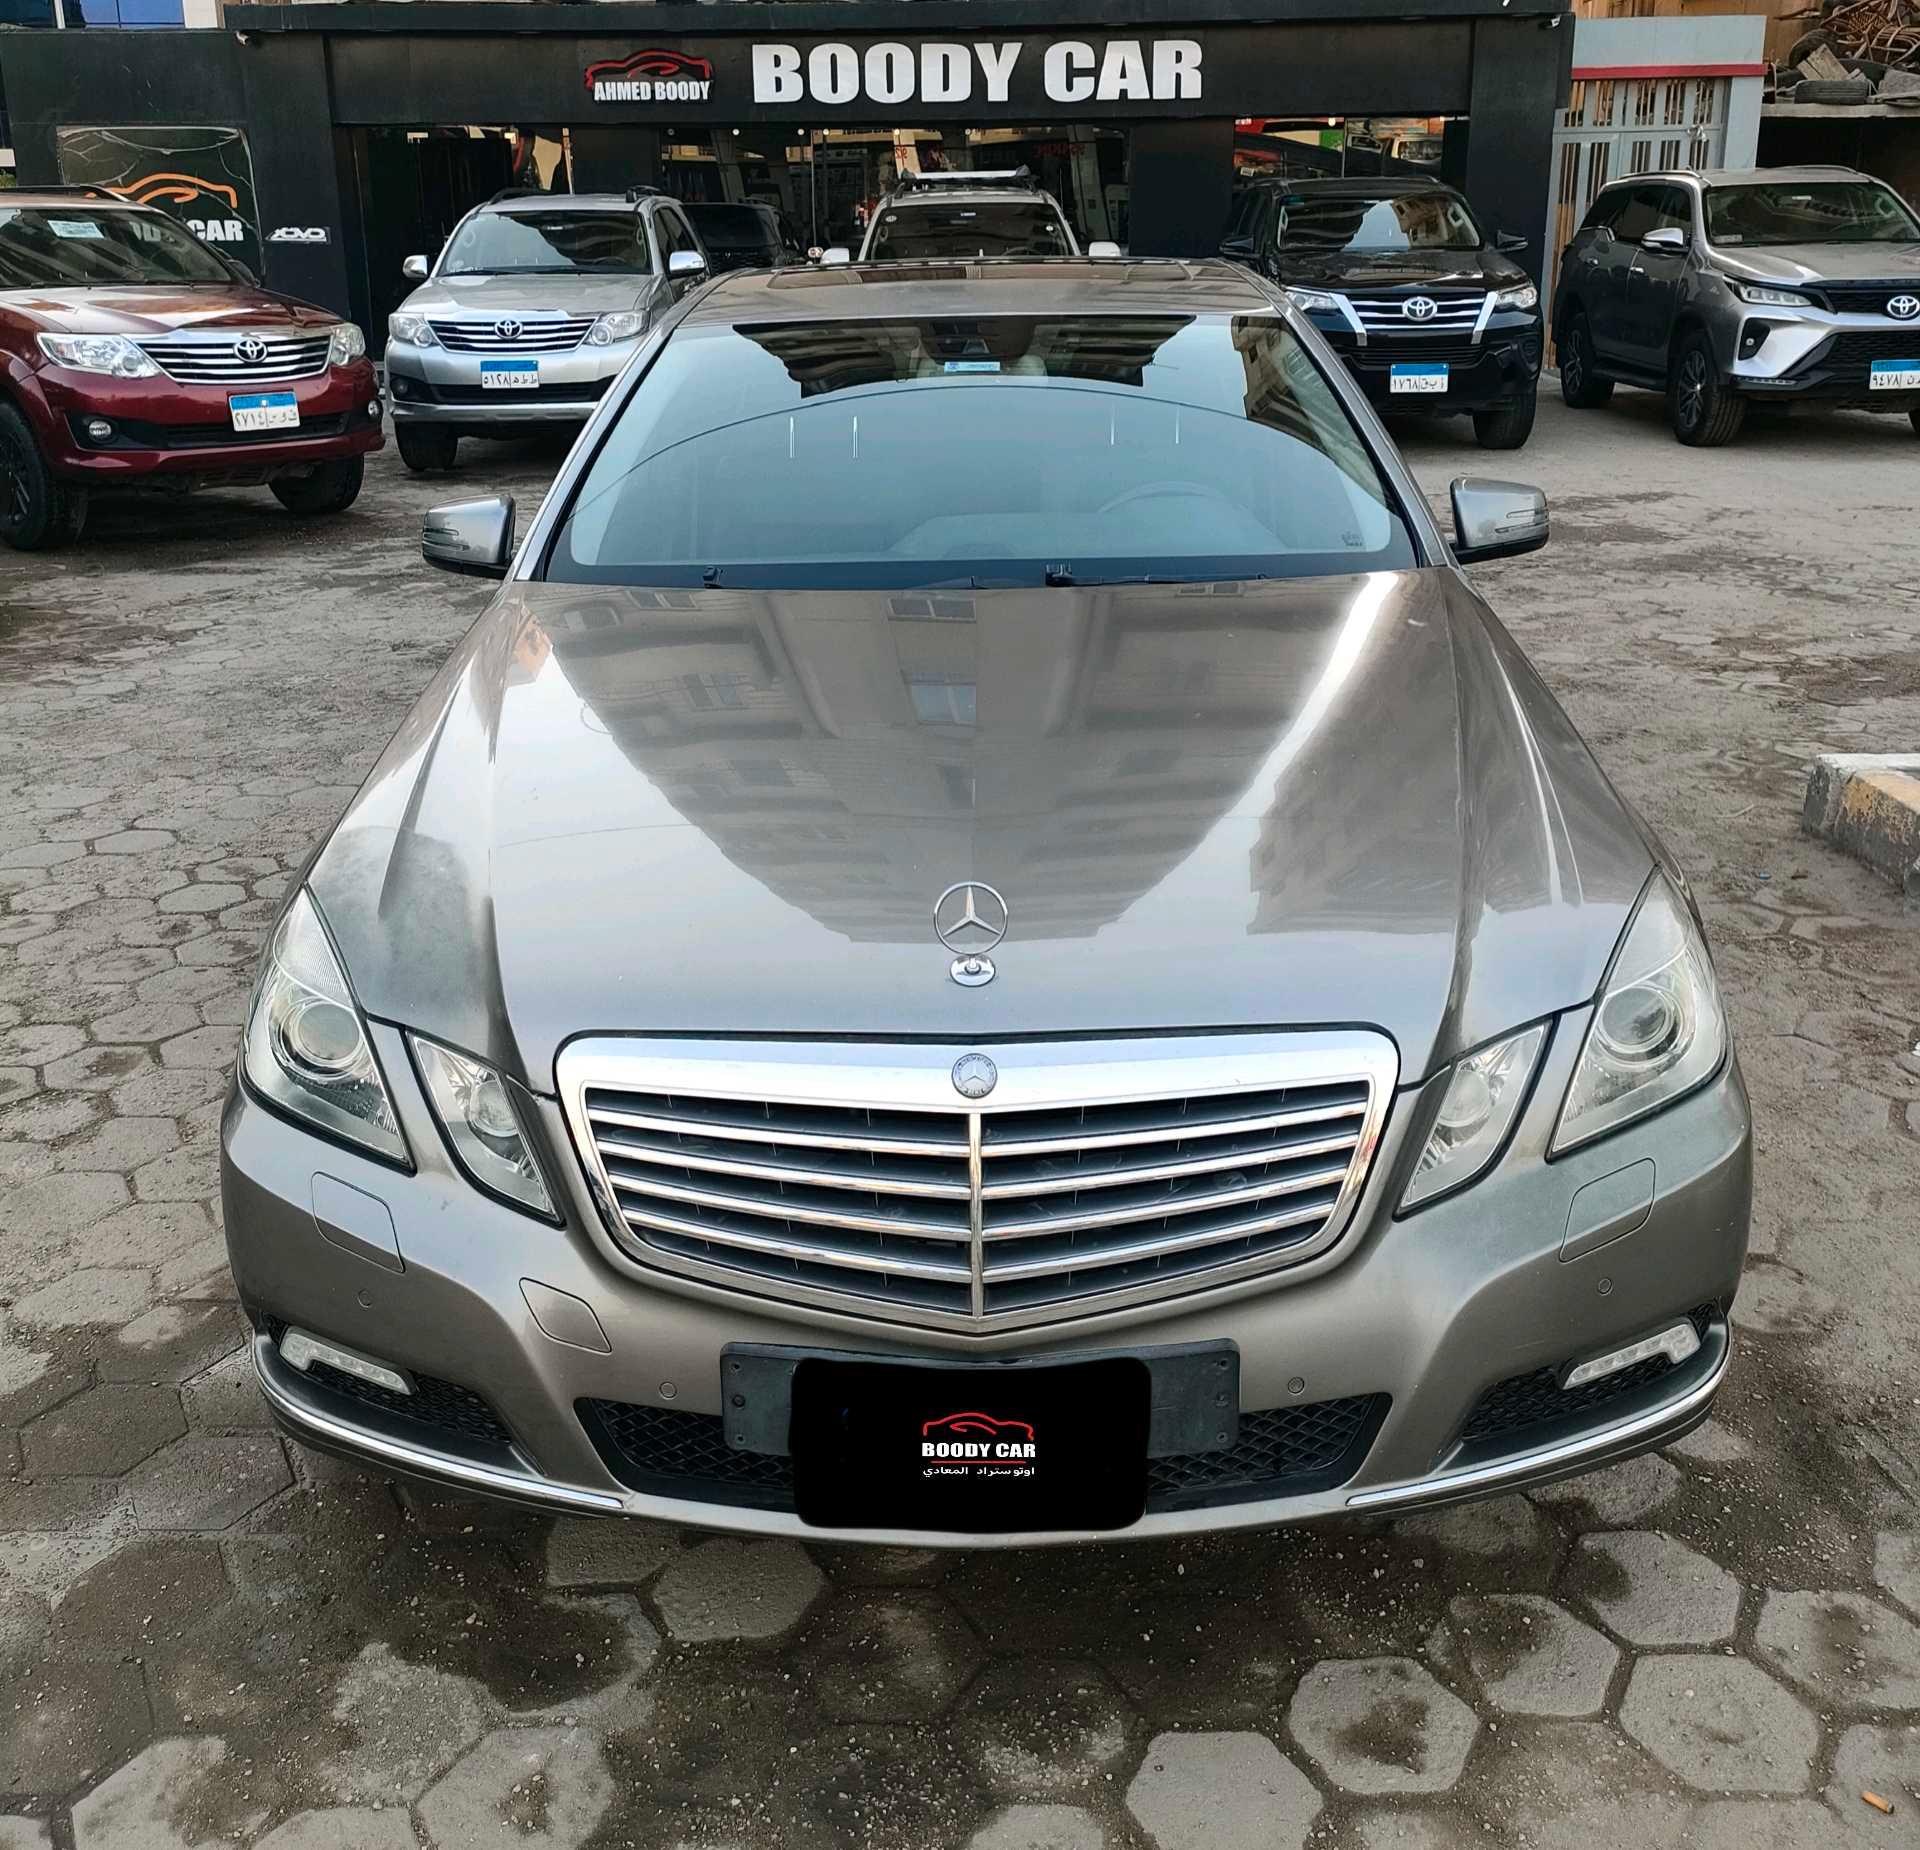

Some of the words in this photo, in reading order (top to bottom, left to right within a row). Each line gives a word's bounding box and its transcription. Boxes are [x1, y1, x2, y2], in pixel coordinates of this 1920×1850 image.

[752, 42, 1023, 103] BOODY
[1044, 40, 1202, 102] CAR
[594, 81, 651, 101] AHMED
[655, 81, 710, 101] BOODY
[185, 219, 244, 241] CAR
